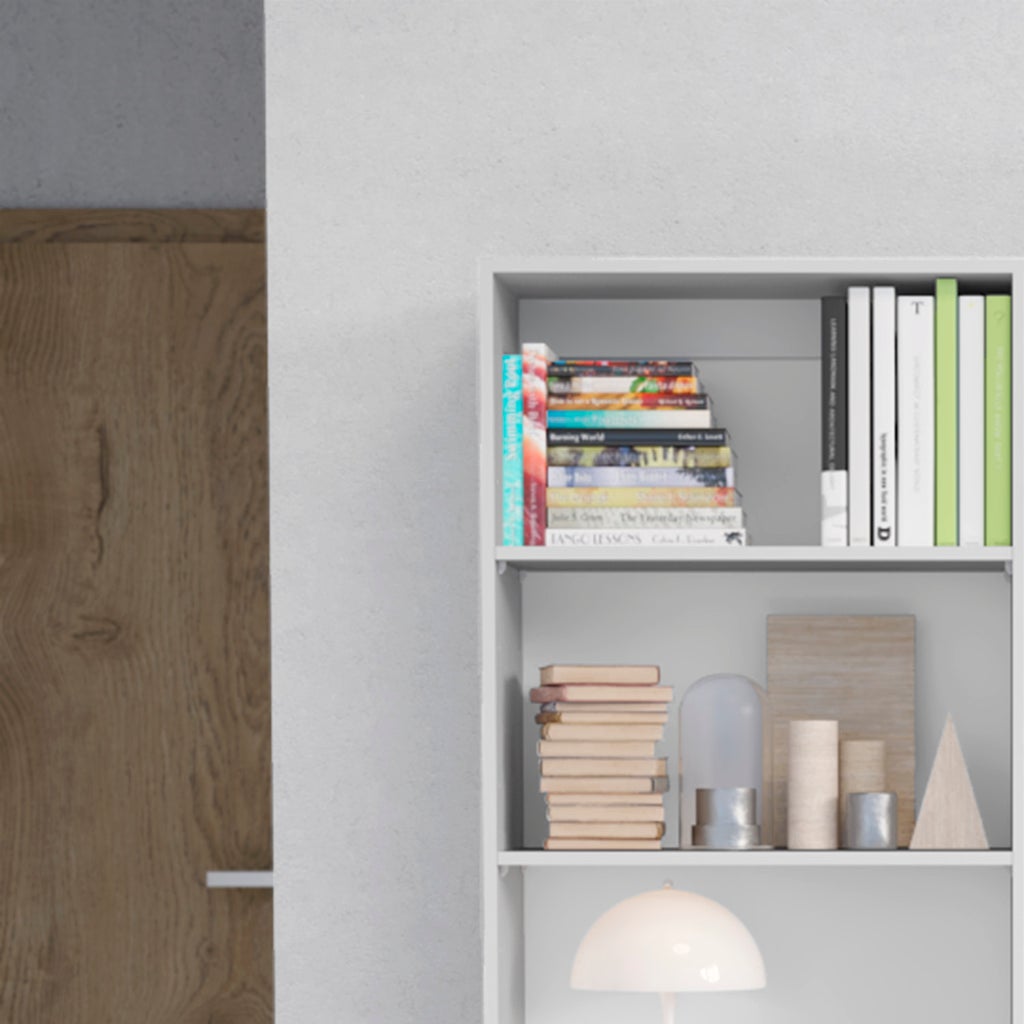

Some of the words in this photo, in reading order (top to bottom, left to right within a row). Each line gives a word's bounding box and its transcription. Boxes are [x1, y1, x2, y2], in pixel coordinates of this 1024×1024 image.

[581, 432, 606, 442] World
[592, 533, 643, 546] LESSONS
[877, 526, 891, 542] D
